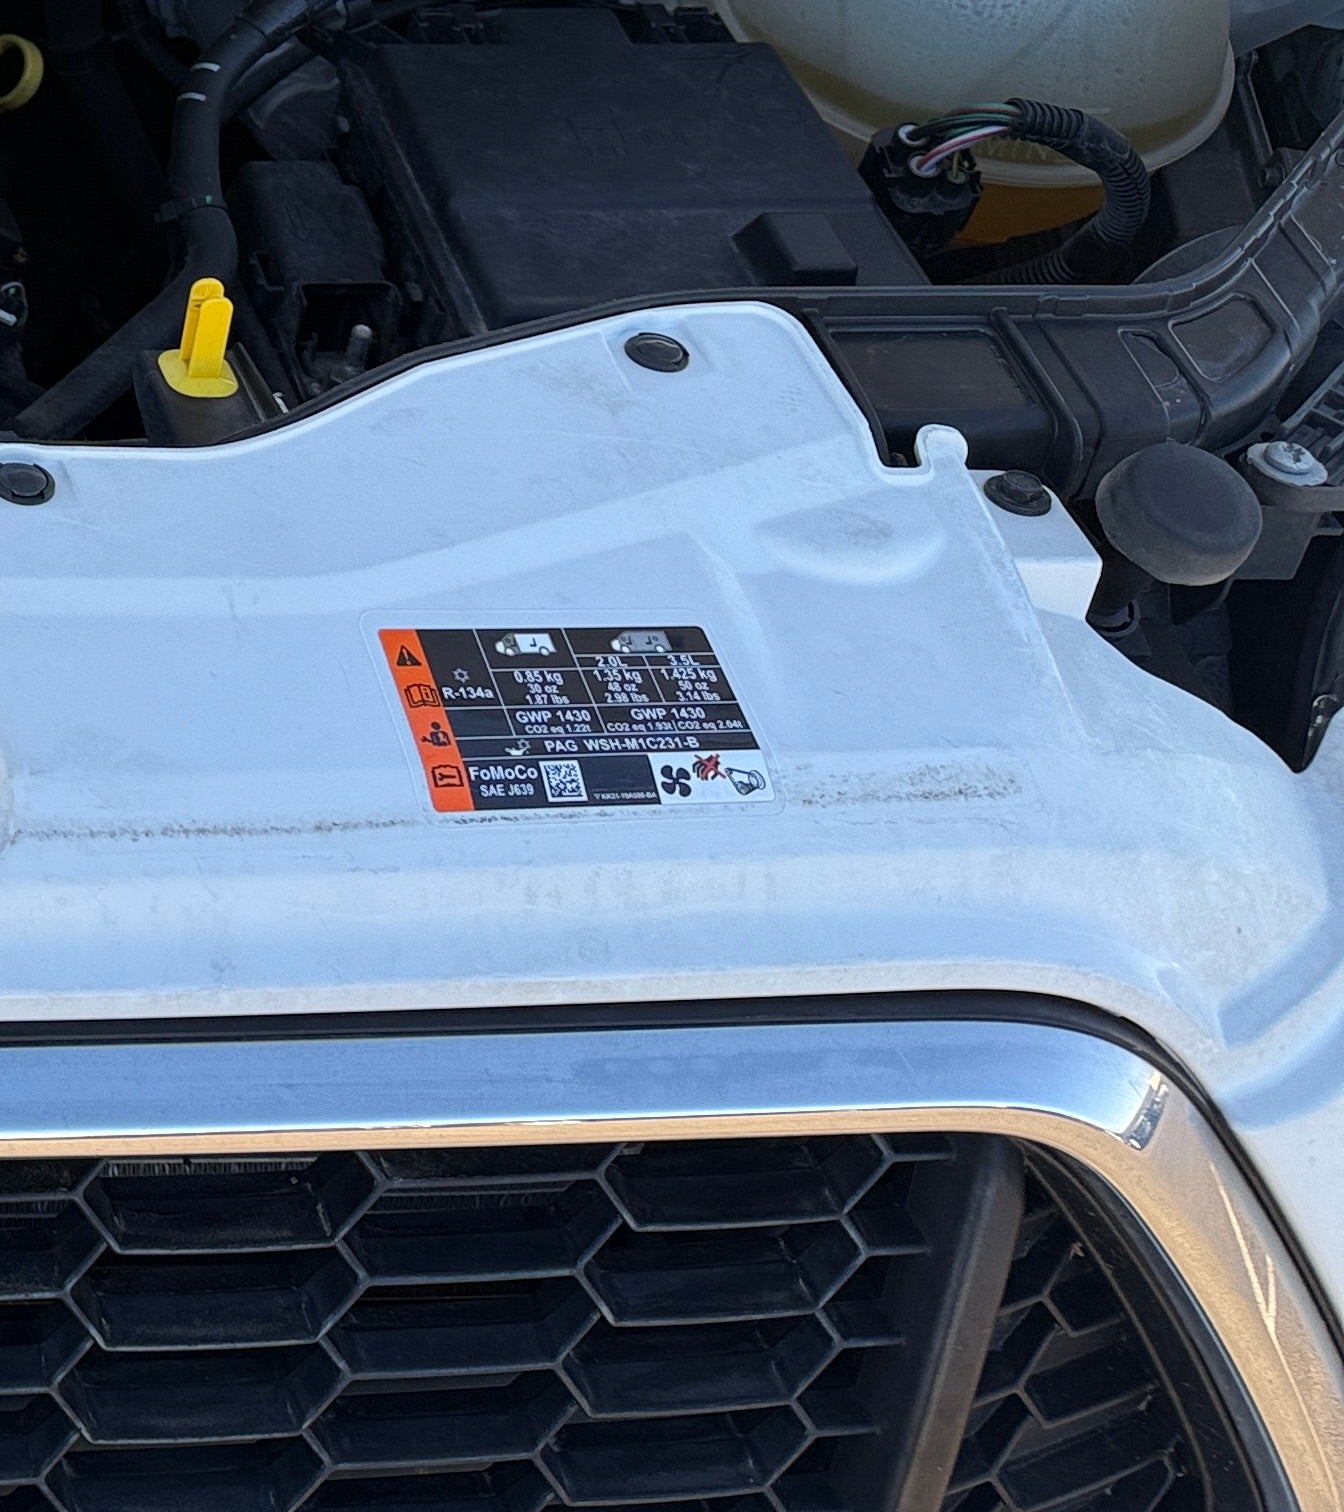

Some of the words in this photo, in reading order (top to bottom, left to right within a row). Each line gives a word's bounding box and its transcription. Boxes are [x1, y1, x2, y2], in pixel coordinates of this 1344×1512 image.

[595, 655, 627, 667] 2.0L
[670, 655, 700, 666] 3.5L
[513, 671, 545, 684] 0.85
[548, 671, 562, 685] kg
[593, 670, 621, 683] 1.35
[624, 670, 641, 684] kg
[661, 668, 697, 681] 1.425
[700, 668, 716, 683] kg
[528, 684, 543, 694] 30
[546, 685, 558, 694] oz
[607, 682, 621, 692] 48
[624, 684, 638, 692] oz
[679, 681, 692, 691] 50
[694, 683, 708, 691] oz
[443, 687, 494, 700] R-134a
[525, 694, 548, 704] 1.87
[551, 694, 569, 704] lbs
[678, 691, 700, 701] 3.14
[702, 691, 721, 701] lbs
[516, 710, 552, 723] GWP
[556, 709, 591, 722] 1430
[631, 708, 666, 721] GWP
[670, 707, 705, 719] 1430
[525, 725, 548, 734] CO2
[607, 723, 629, 732] CO2
[678, 721, 699, 730] CO2
[545, 740, 578, 753] PAG
[583, 737, 699, 751] WSH-M1C231-B
[469, 766, 538, 782] FoMoCo
[480, 785, 504, 797] SAE
[507, 784, 535, 797] J639
